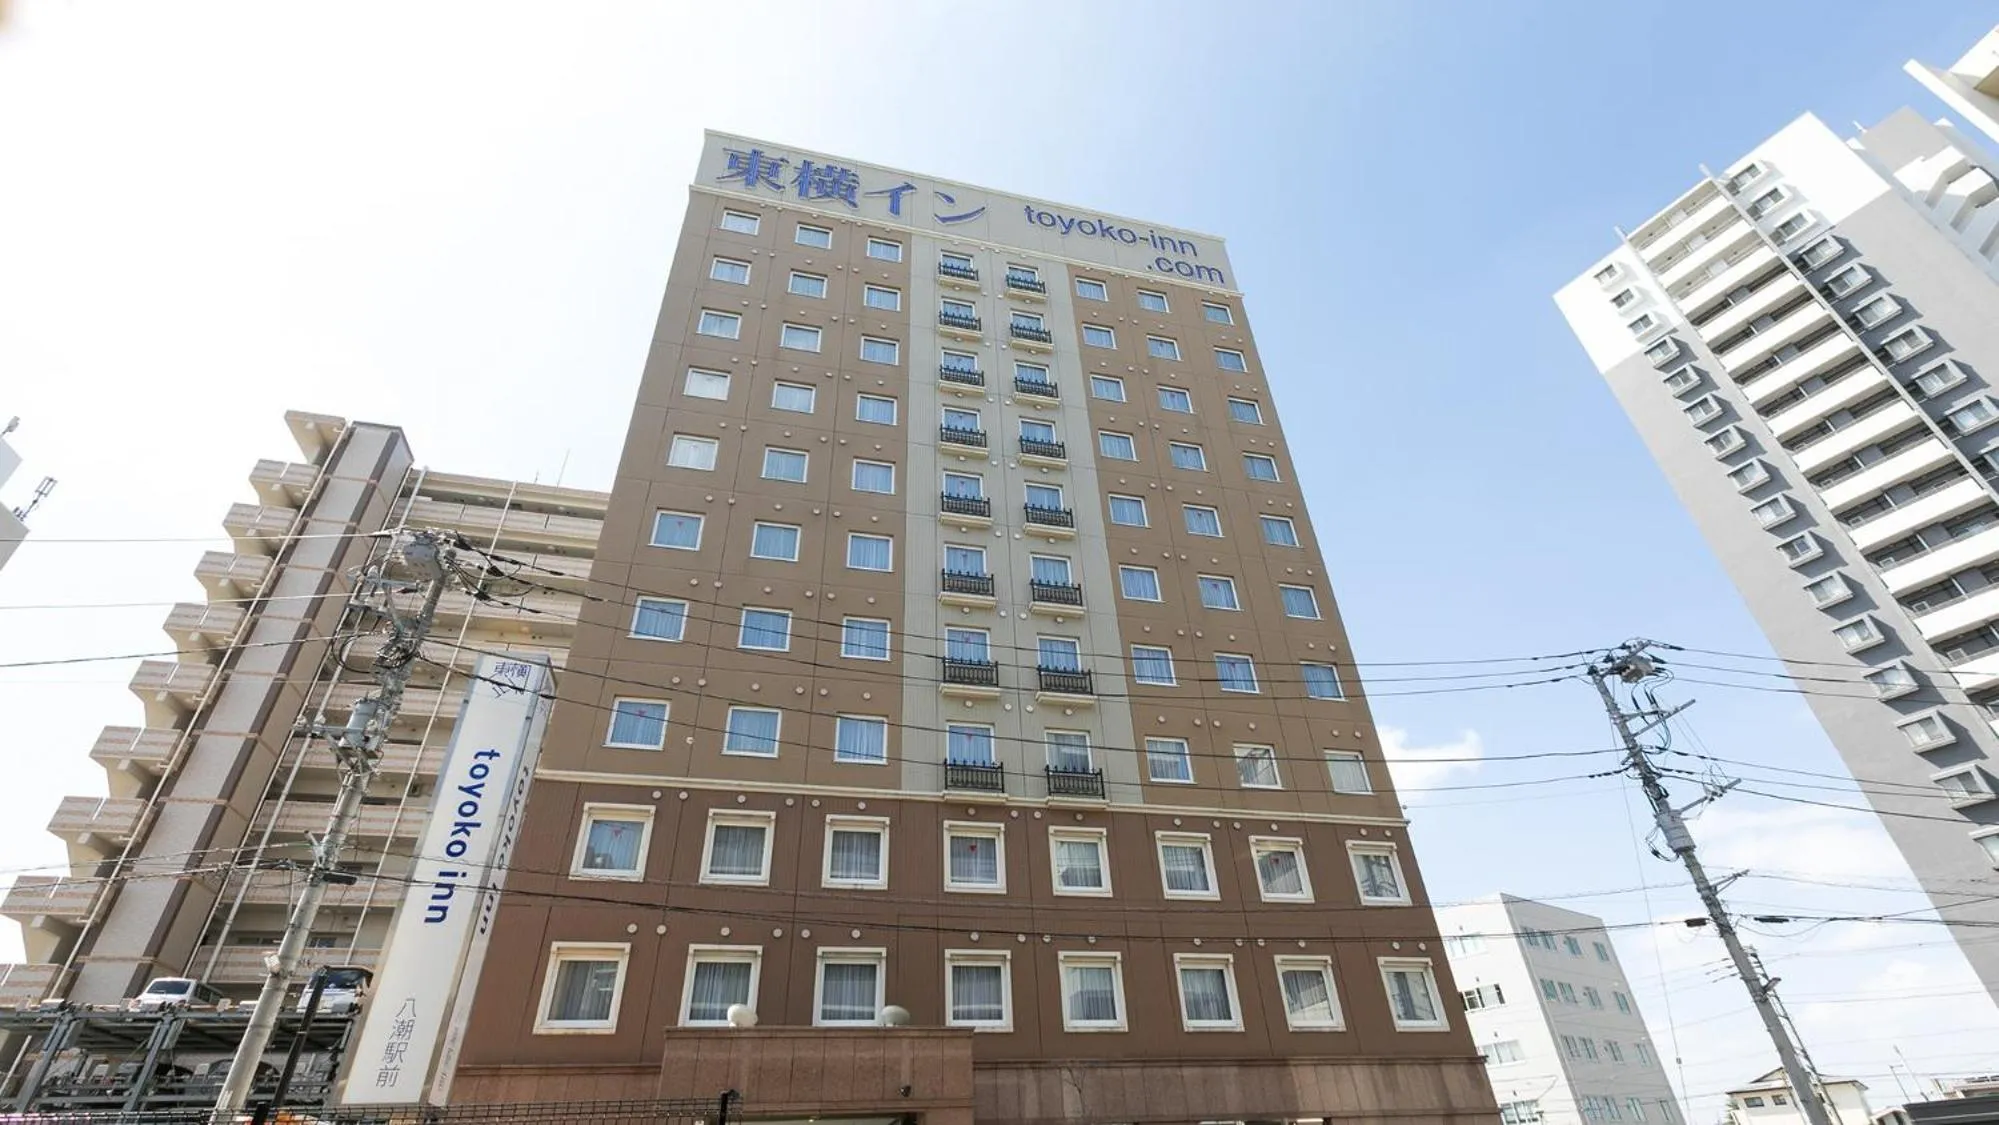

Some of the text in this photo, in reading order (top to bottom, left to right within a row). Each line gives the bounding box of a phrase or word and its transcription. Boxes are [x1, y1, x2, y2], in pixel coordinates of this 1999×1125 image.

[716, 148, 987, 225] 東横イン
[1024, 205, 1198, 257] toyoko-inn
[1148, 256, 1235, 284] .com
[424, 749, 500, 923] toyoko inn
[376, 998, 416, 1088] 八潮駅前
